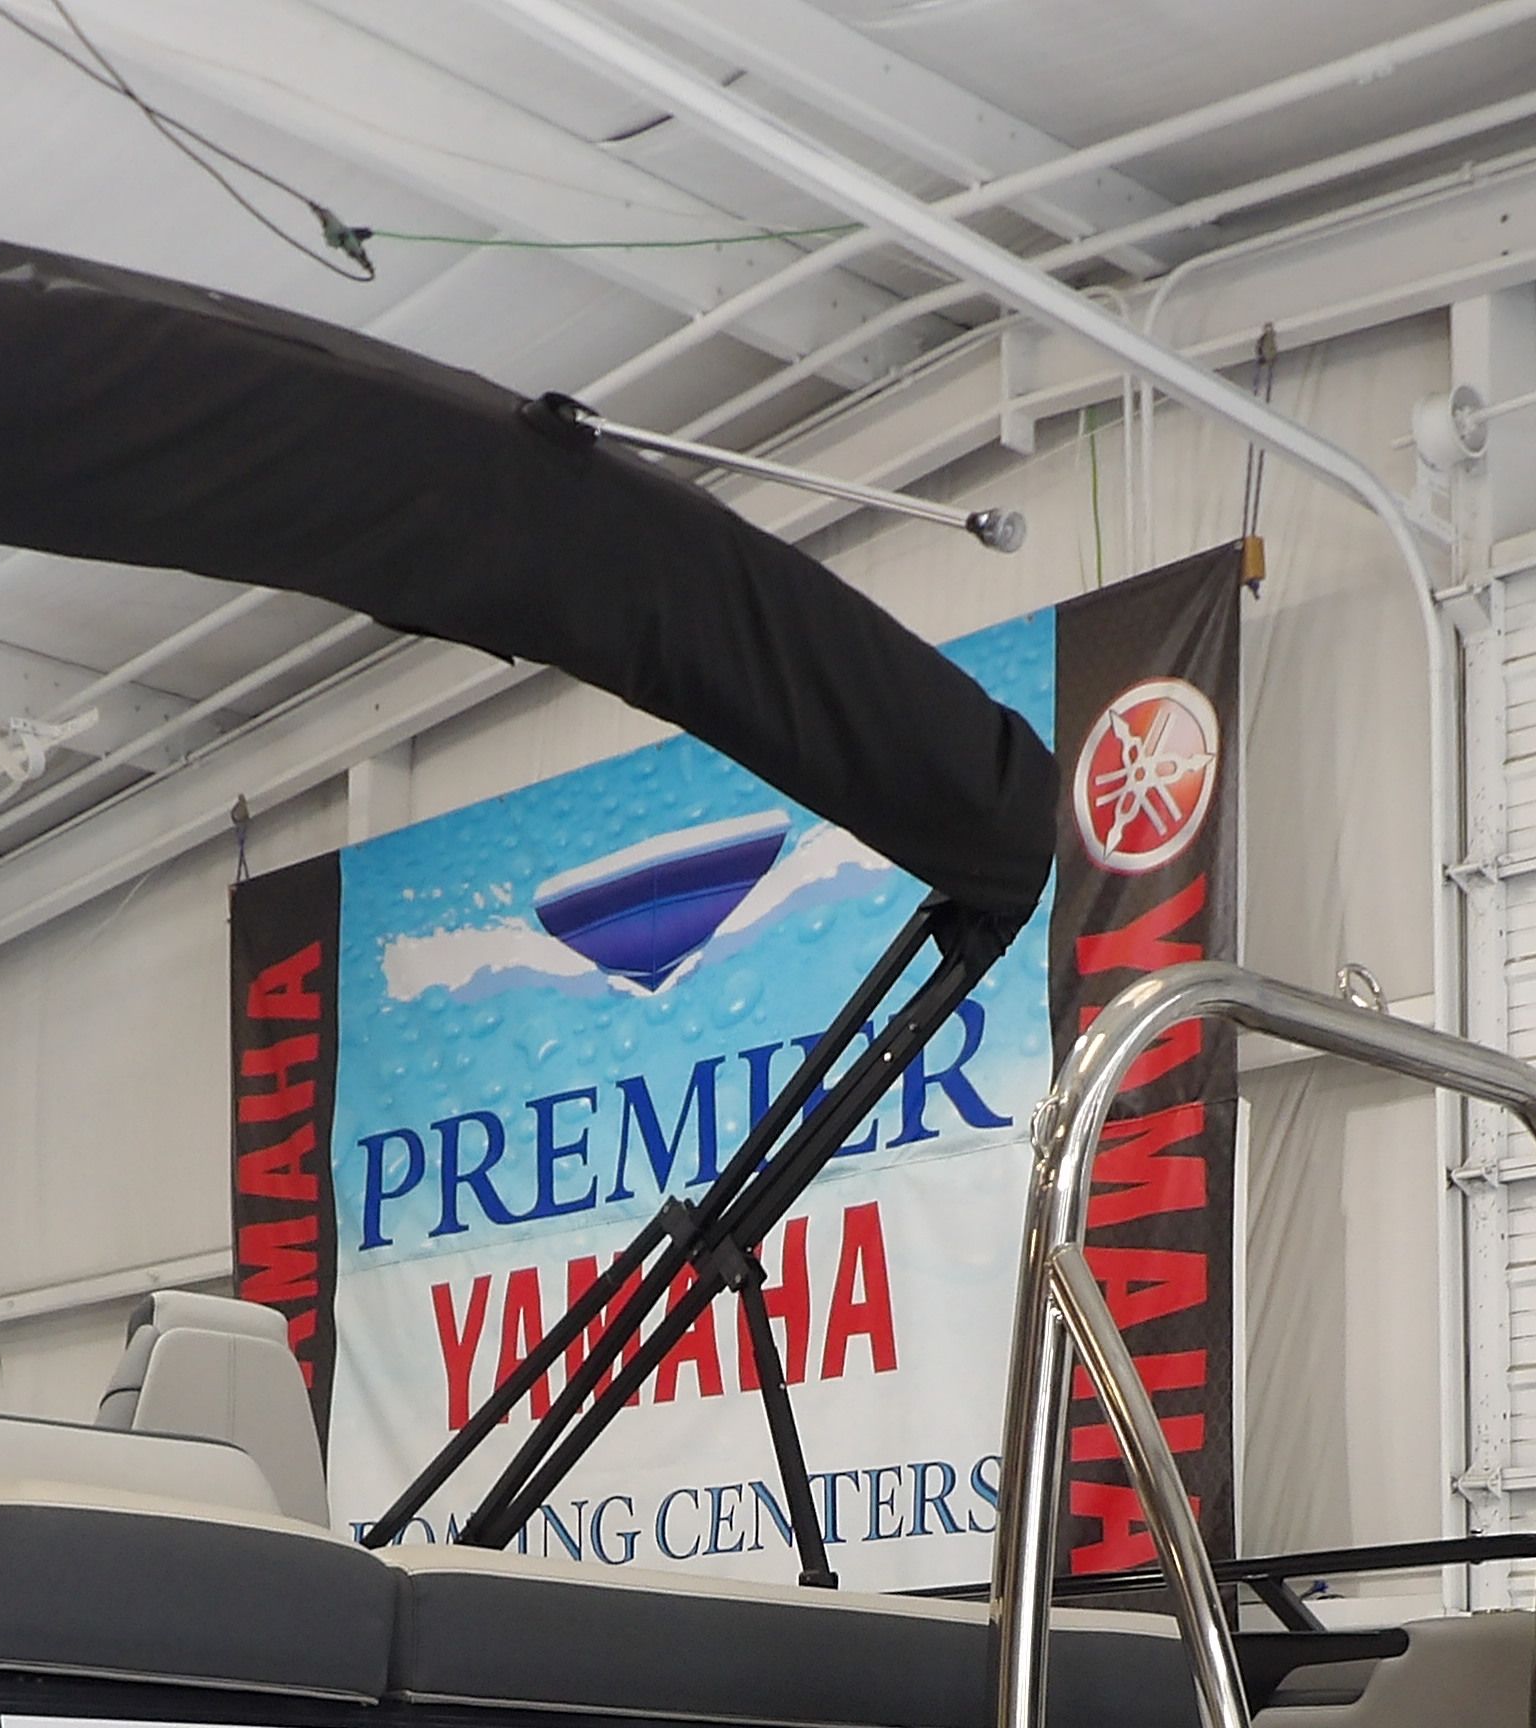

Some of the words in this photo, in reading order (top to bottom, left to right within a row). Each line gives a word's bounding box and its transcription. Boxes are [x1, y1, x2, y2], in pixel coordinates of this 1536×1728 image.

[237, 941, 322, 1389] MAHA
[431, 1201, 899, 1432] YAMAHA
[349, 1496, 642, 1566] OING
[656, 1455, 1003, 1561] CENTERS
